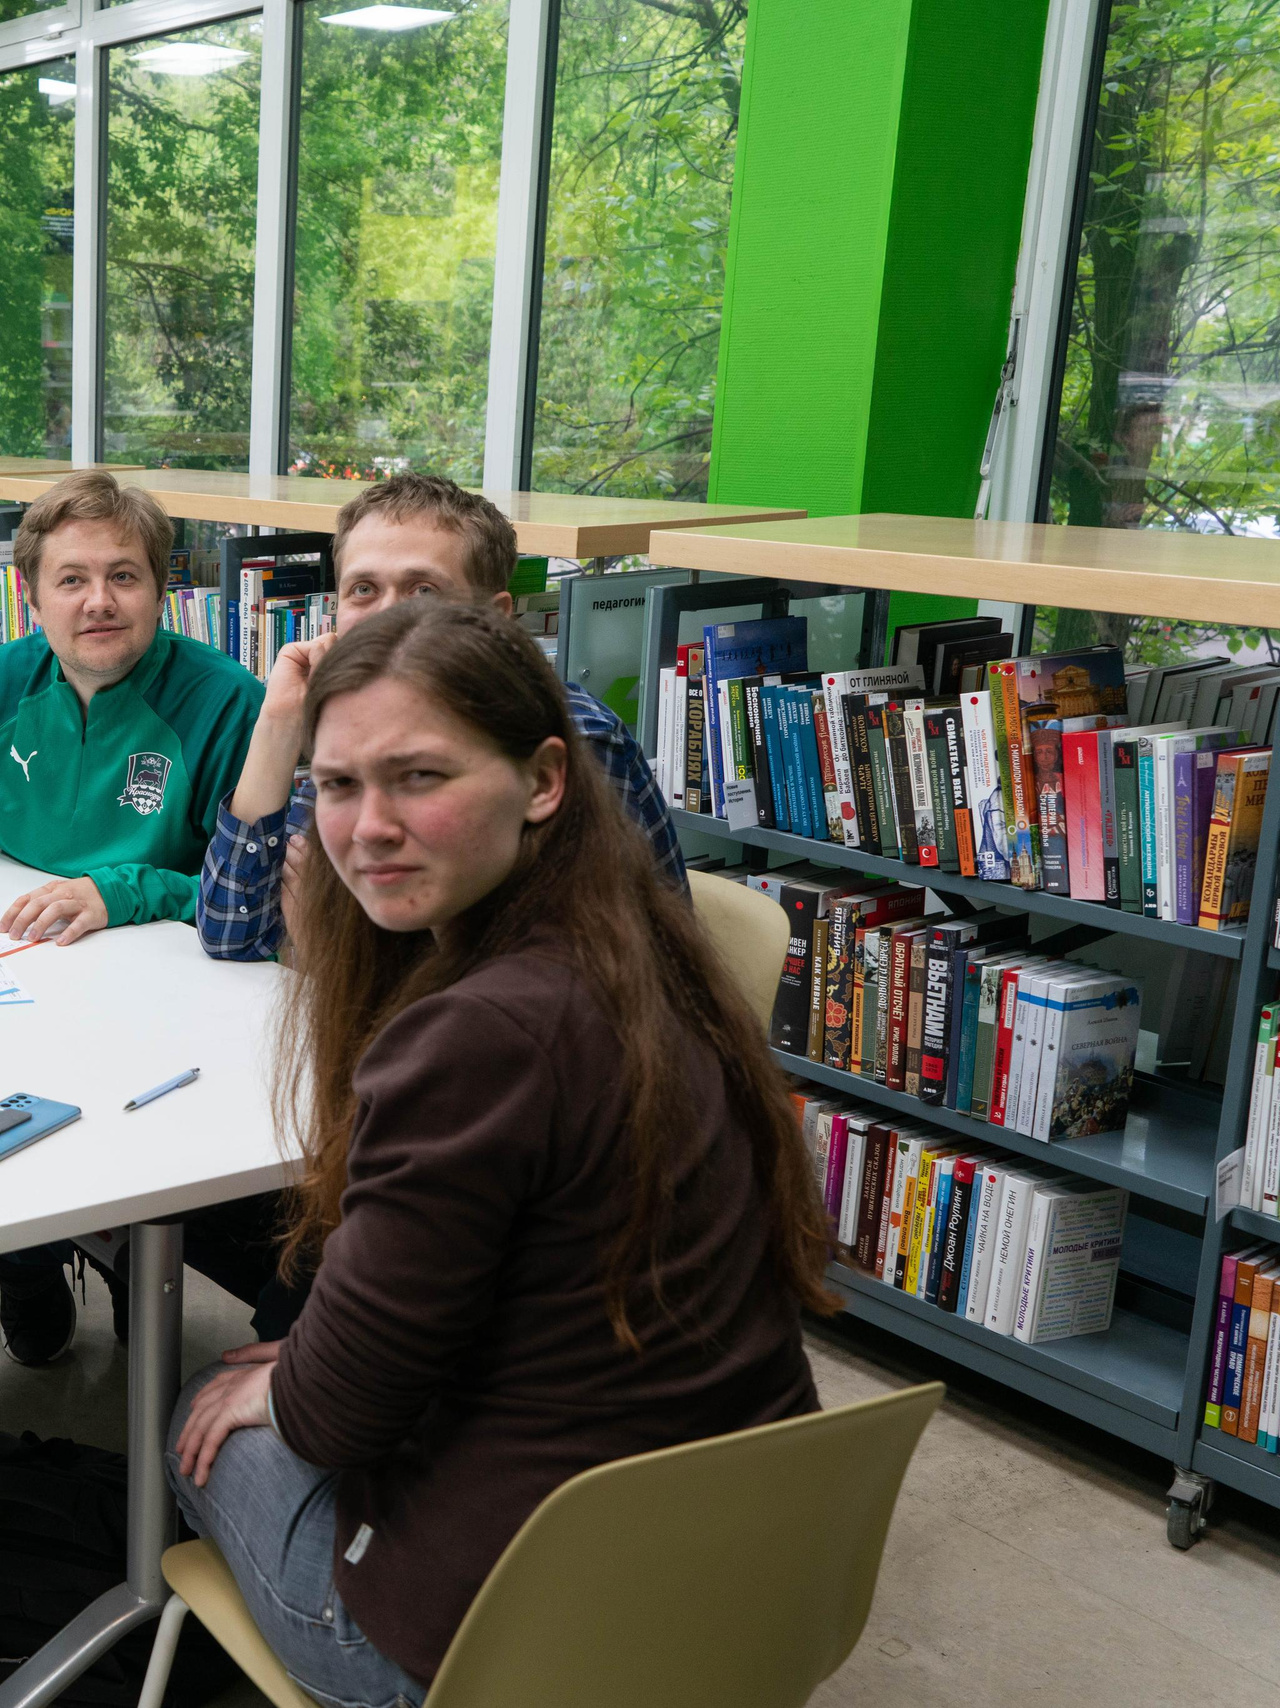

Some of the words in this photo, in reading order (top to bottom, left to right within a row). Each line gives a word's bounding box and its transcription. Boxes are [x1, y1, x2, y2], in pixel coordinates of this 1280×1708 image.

[593, 597, 646, 611] педагогик
[688, 689, 698, 697] ВСЕ
[850, 678, 861, 688] ОТ
[863, 671, 909, 687] ГЛИНЯНОЙ
[746, 687, 754, 728] империя
[751, 686, 763, 746] Бесконечная
[826, 686, 835, 718] таблички
[688, 699, 703, 781] КОРАБЛЯХ
[830, 720, 838, 752] глиняной
[857, 714, 868, 753] БОХАНОВ
[945, 717, 960, 776] СВИДЕТЕЛЬ
[836, 768, 844, 795] Кирилл
[858, 764, 866, 789] ЦАРЬ
[1011, 749, 1022, 783] МИХАИЛОМ
[951, 779, 962, 805] ВЕКА
[1015, 784, 1024, 817] ЖЕБРАКОМ
[1203, 833, 1218, 903] КОМАНДАРМЫ
[1215, 831, 1227, 875] МИРОВОЙ
[1211, 875, 1221, 909] ПЕРВОЙ
[789, 937, 807, 948] ИВЕН
[833, 907, 842, 956] ЯПОНИЯ
[814, 956, 823, 975] КАК
[893, 941, 906, 987] ОБРАТНЫЙ
[812, 977, 821, 1010] ЖИВЫЕ
[892, 989, 905, 1021] ОТСЧЁТ
[924, 958, 948, 1037] ВЬЕТНАМ
[890, 1042, 899, 1066] УОЛЛЕС
[1071, 1041, 1104, 1051] СЕВЕРНАЯ
[1105, 1037, 1128, 1047] ВОЙНА
[863, 1159, 872, 1198] ЗАКУЛИСЬЕ
[866, 1171, 878, 1220] ПУШКИНСКИХ
[872, 1142, 881, 1170] СКАЗОК
[983, 1182, 994, 1208] ВОДЕ
[903, 1210, 911, 1225] Вам
[948, 1186, 963, 1231] Роулинг
[981, 1208, 990, 1222] НА
[1005, 1189, 1017, 1229] ОНЕГИН
[900, 1226, 909, 1250] слово!
[943, 1233, 958, 1271] Джоан
[977, 1223, 988, 1255] ЧАЙКА
[1000, 1230, 1011, 1264] НЕМОЙ
[1053, 1242, 1089, 1255] МОЛОДЫЕ
[1090, 1237, 1121, 1249] КРИТИКИ
[1016, 1287, 1030, 1331] МОЛОДЫЕ
[1023, 1247, 1036, 1286] КРИТИКИ
[1214, 1330, 1224, 1368] МЕЖДУНАРОДНОЕ
[1228, 1351, 1236, 1370] ПРАВО
[1233, 1353, 1243, 1396] КОММЕРЧЕСКОЕ
